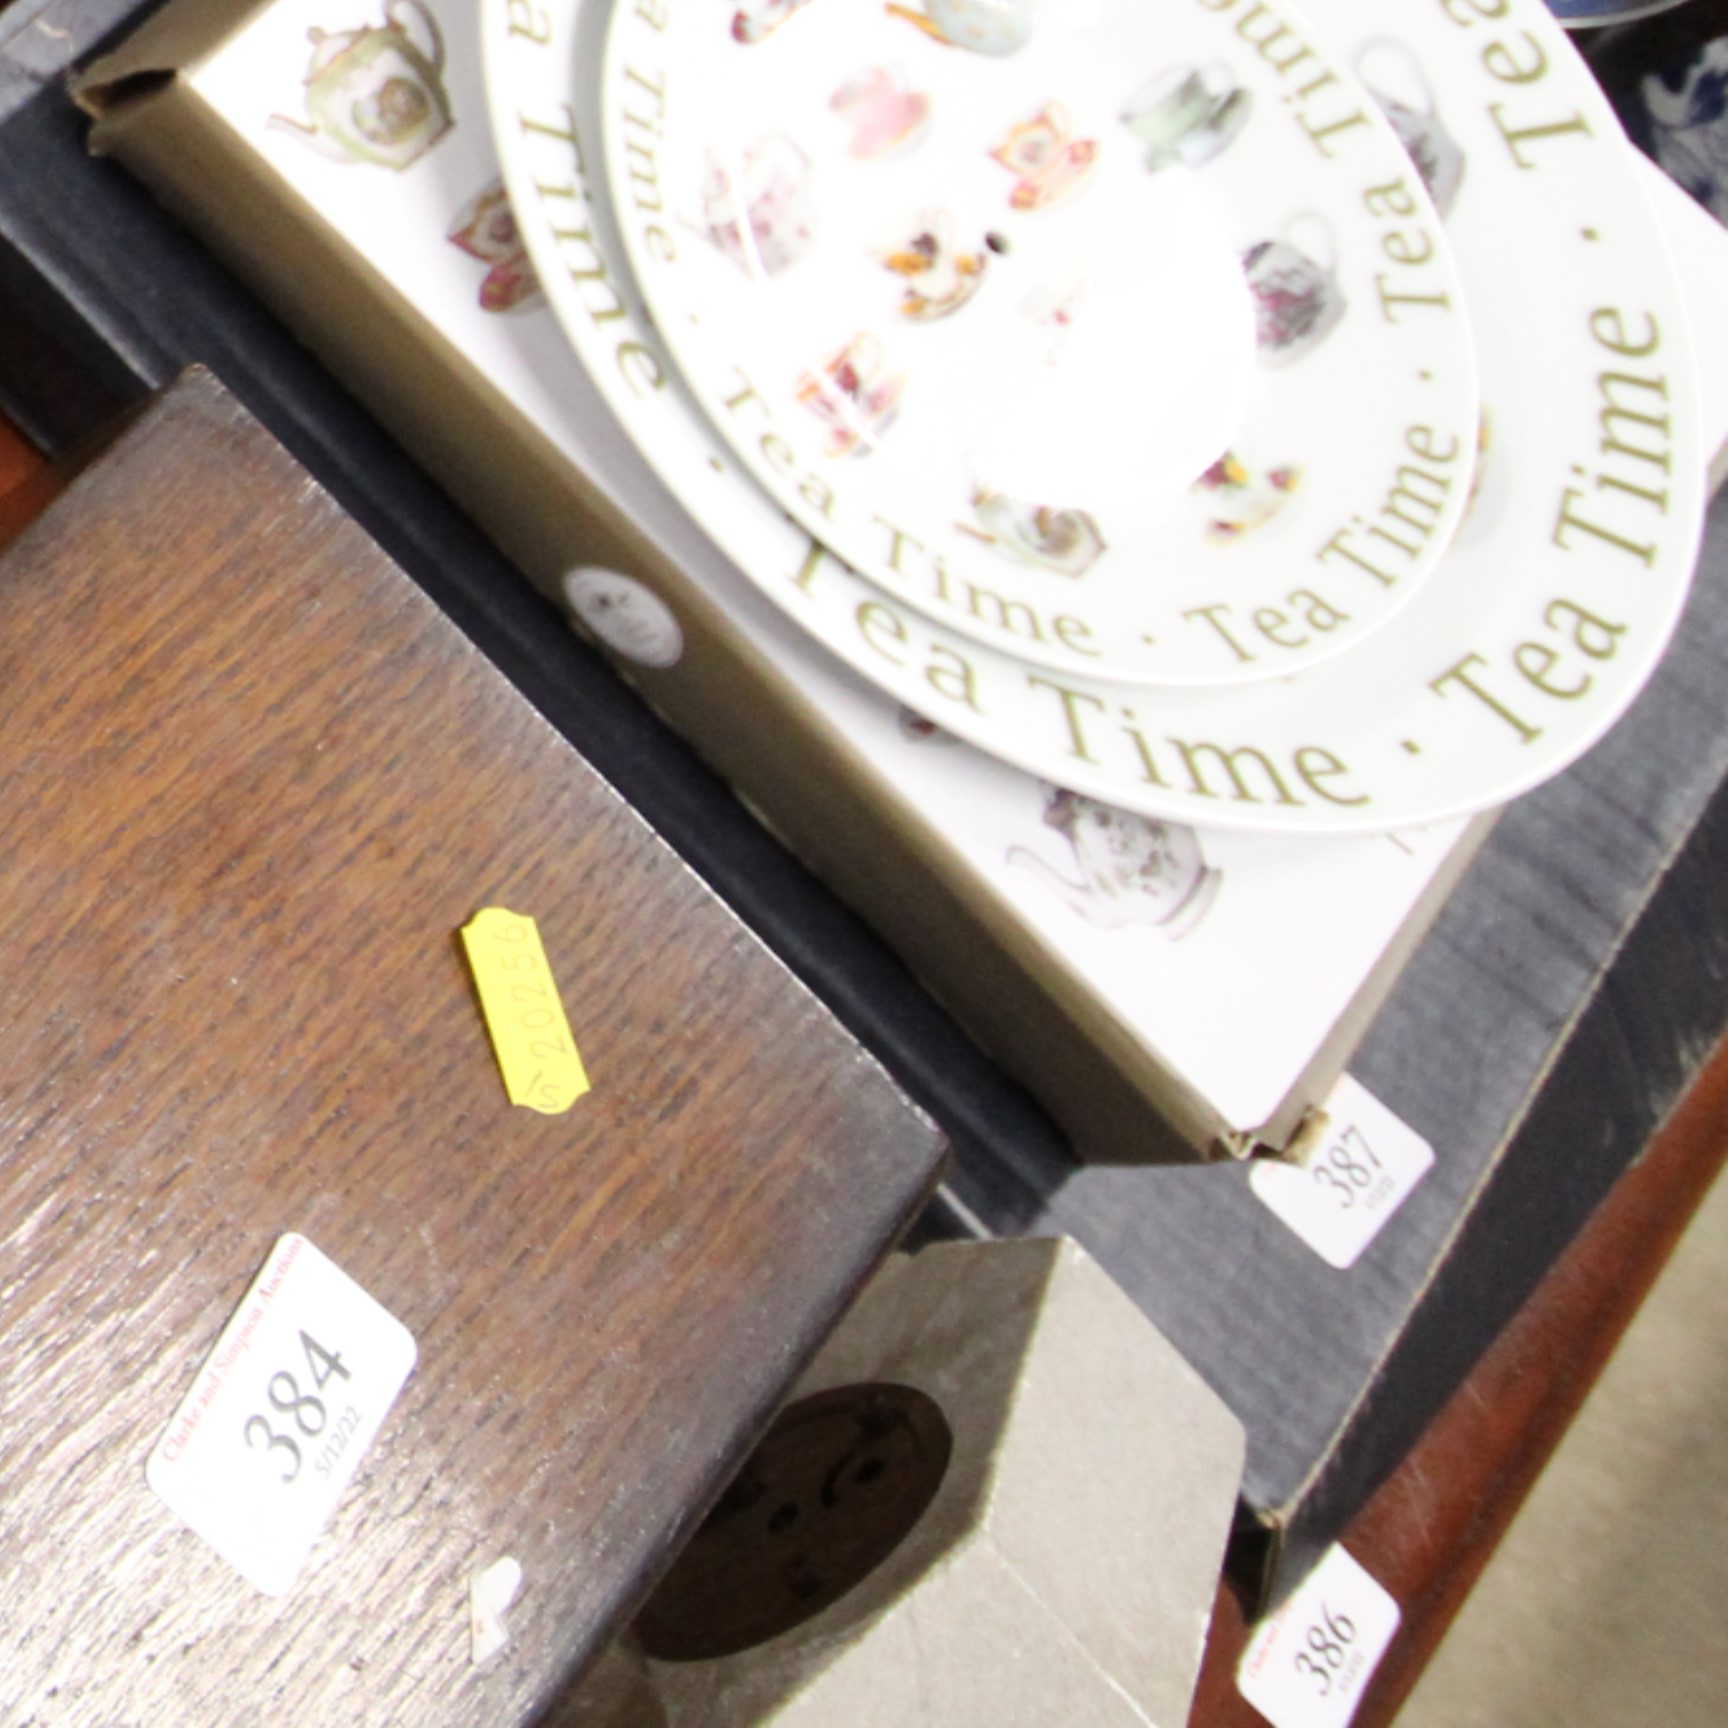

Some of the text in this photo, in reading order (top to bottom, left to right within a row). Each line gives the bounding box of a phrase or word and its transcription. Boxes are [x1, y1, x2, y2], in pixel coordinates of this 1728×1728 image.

[518, 103, 670, 399] Time
[623, 62, 677, 265] Time
[1363, 177, 1452, 324] Tea
[718, 364, 1103, 658] Tea Time
[1181, 420, 1460, 666] Tea Time
[1429, 305, 1674, 749] Tea Time
[785, 537, 1373, 808] Tea Time
[1313, 1124, 1382, 1209] 387
[161, 1236, 307, 1463] Clarke and Simpson Auctions
[244, 1328, 353, 1485] 384
[314, 1404, 363, 1480] 5/12/22
[1295, 1600, 1356, 1697] 386
